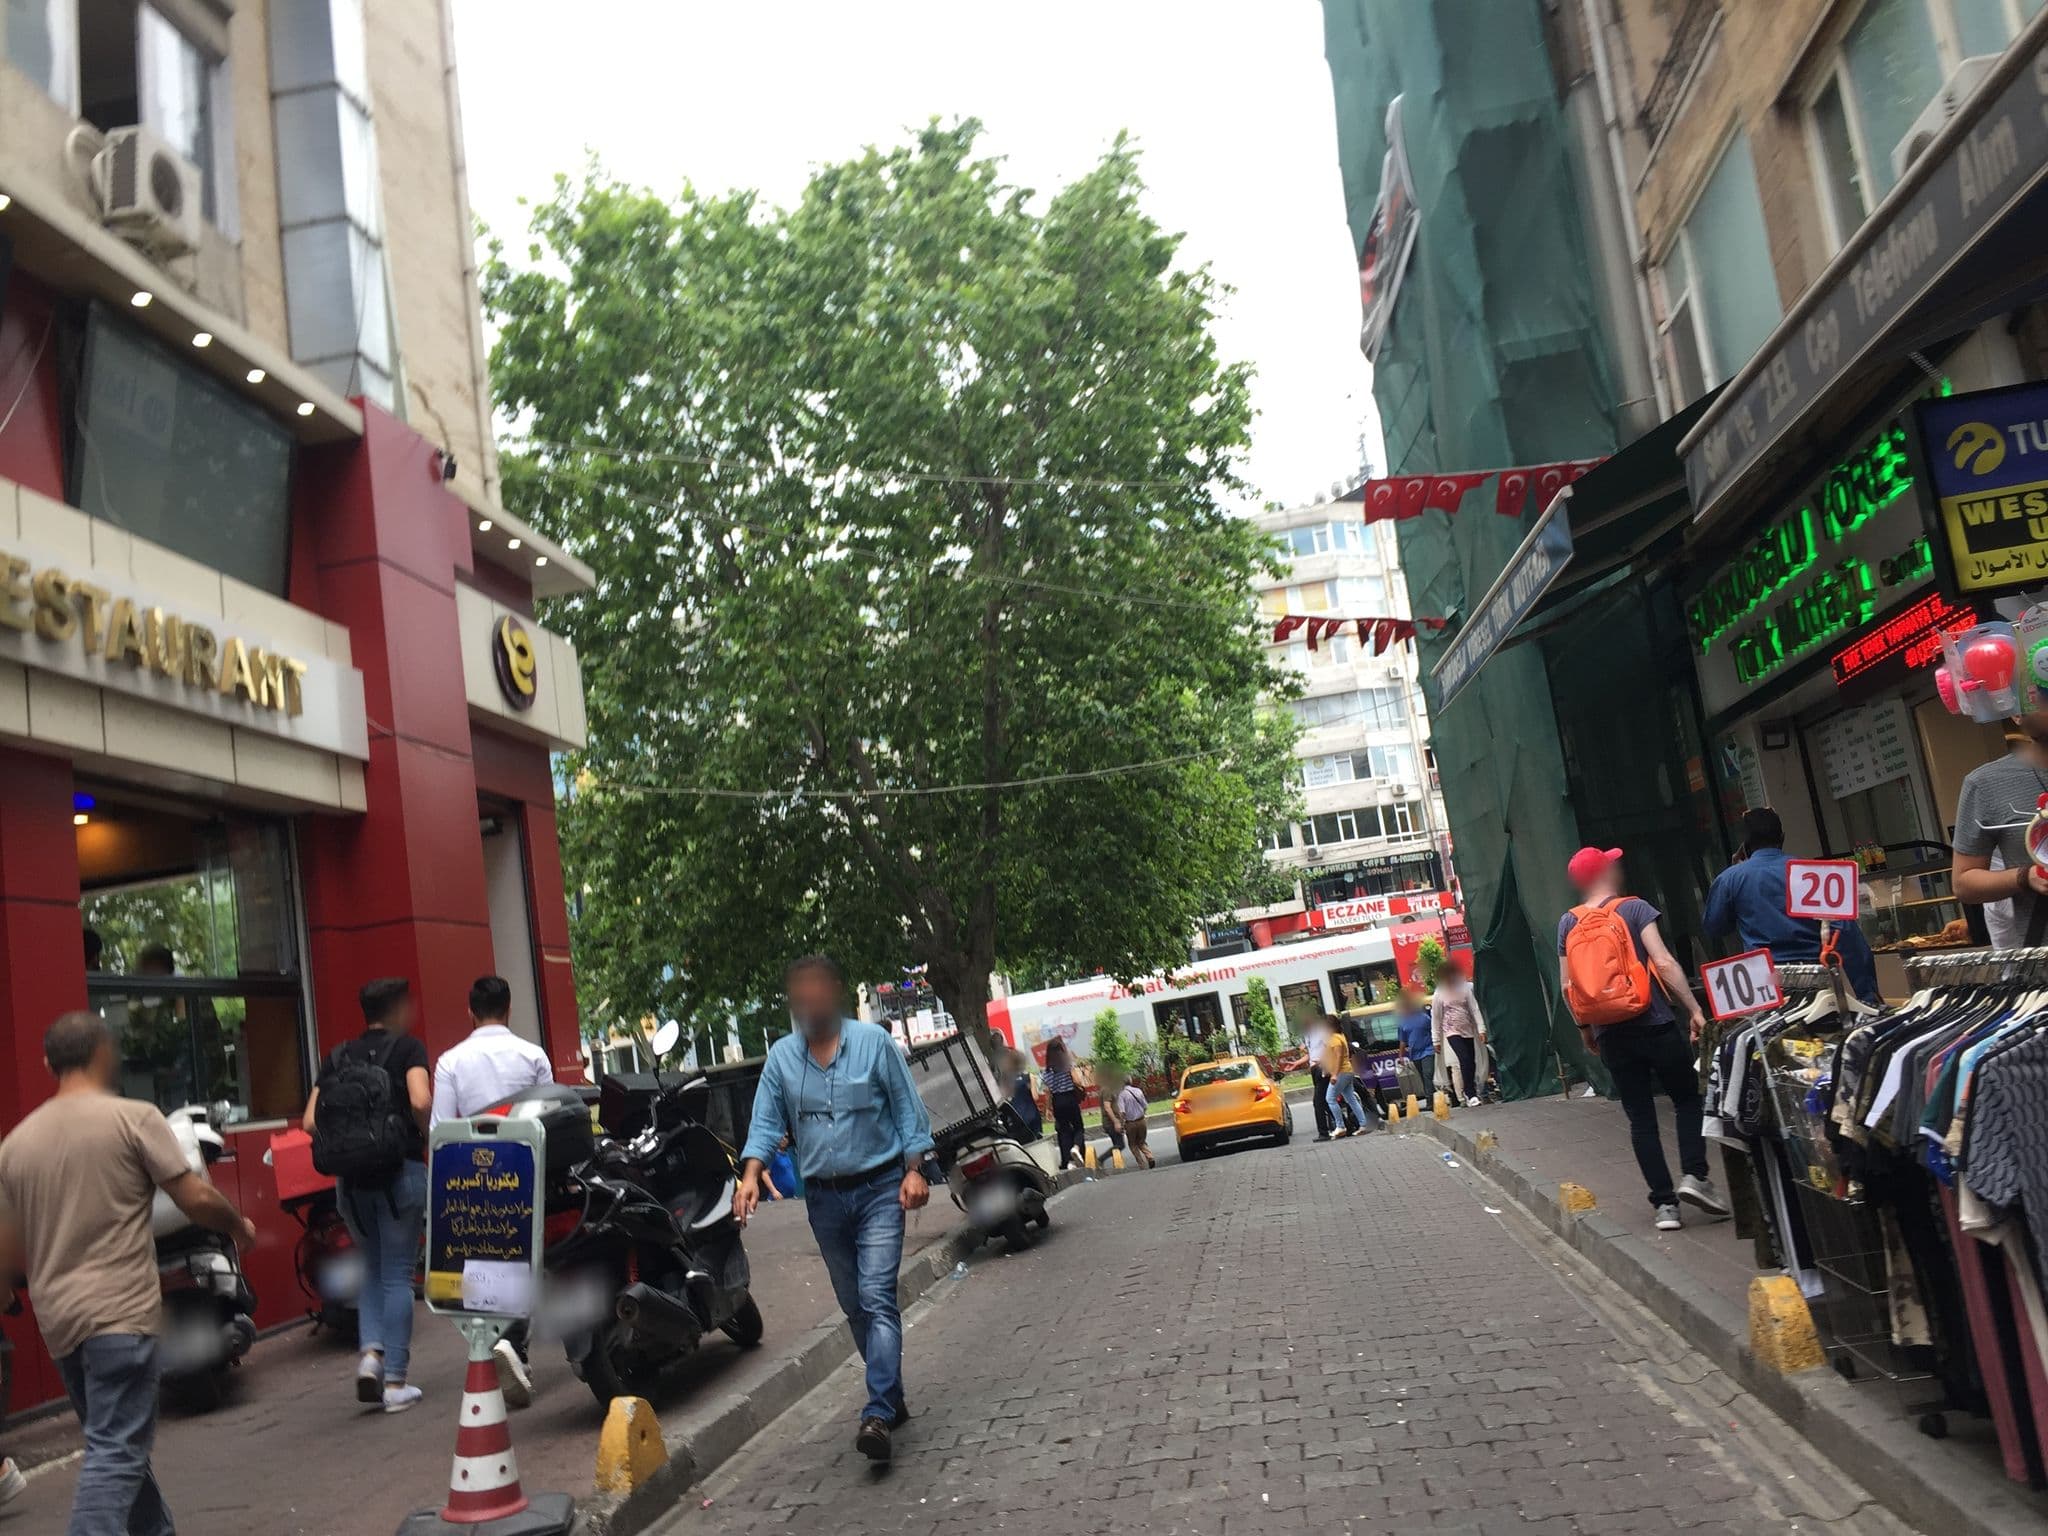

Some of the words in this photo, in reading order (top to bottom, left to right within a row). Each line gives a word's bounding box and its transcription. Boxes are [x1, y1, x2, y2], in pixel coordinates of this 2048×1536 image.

[1849, 201, 1938, 326] Telefonu
[1326, 900, 1386, 919] ECZANE
[1801, 872, 1845, 908] 20
[1716, 963, 1755, 1010] 10
[1756, 985, 1776, 1000] TL
